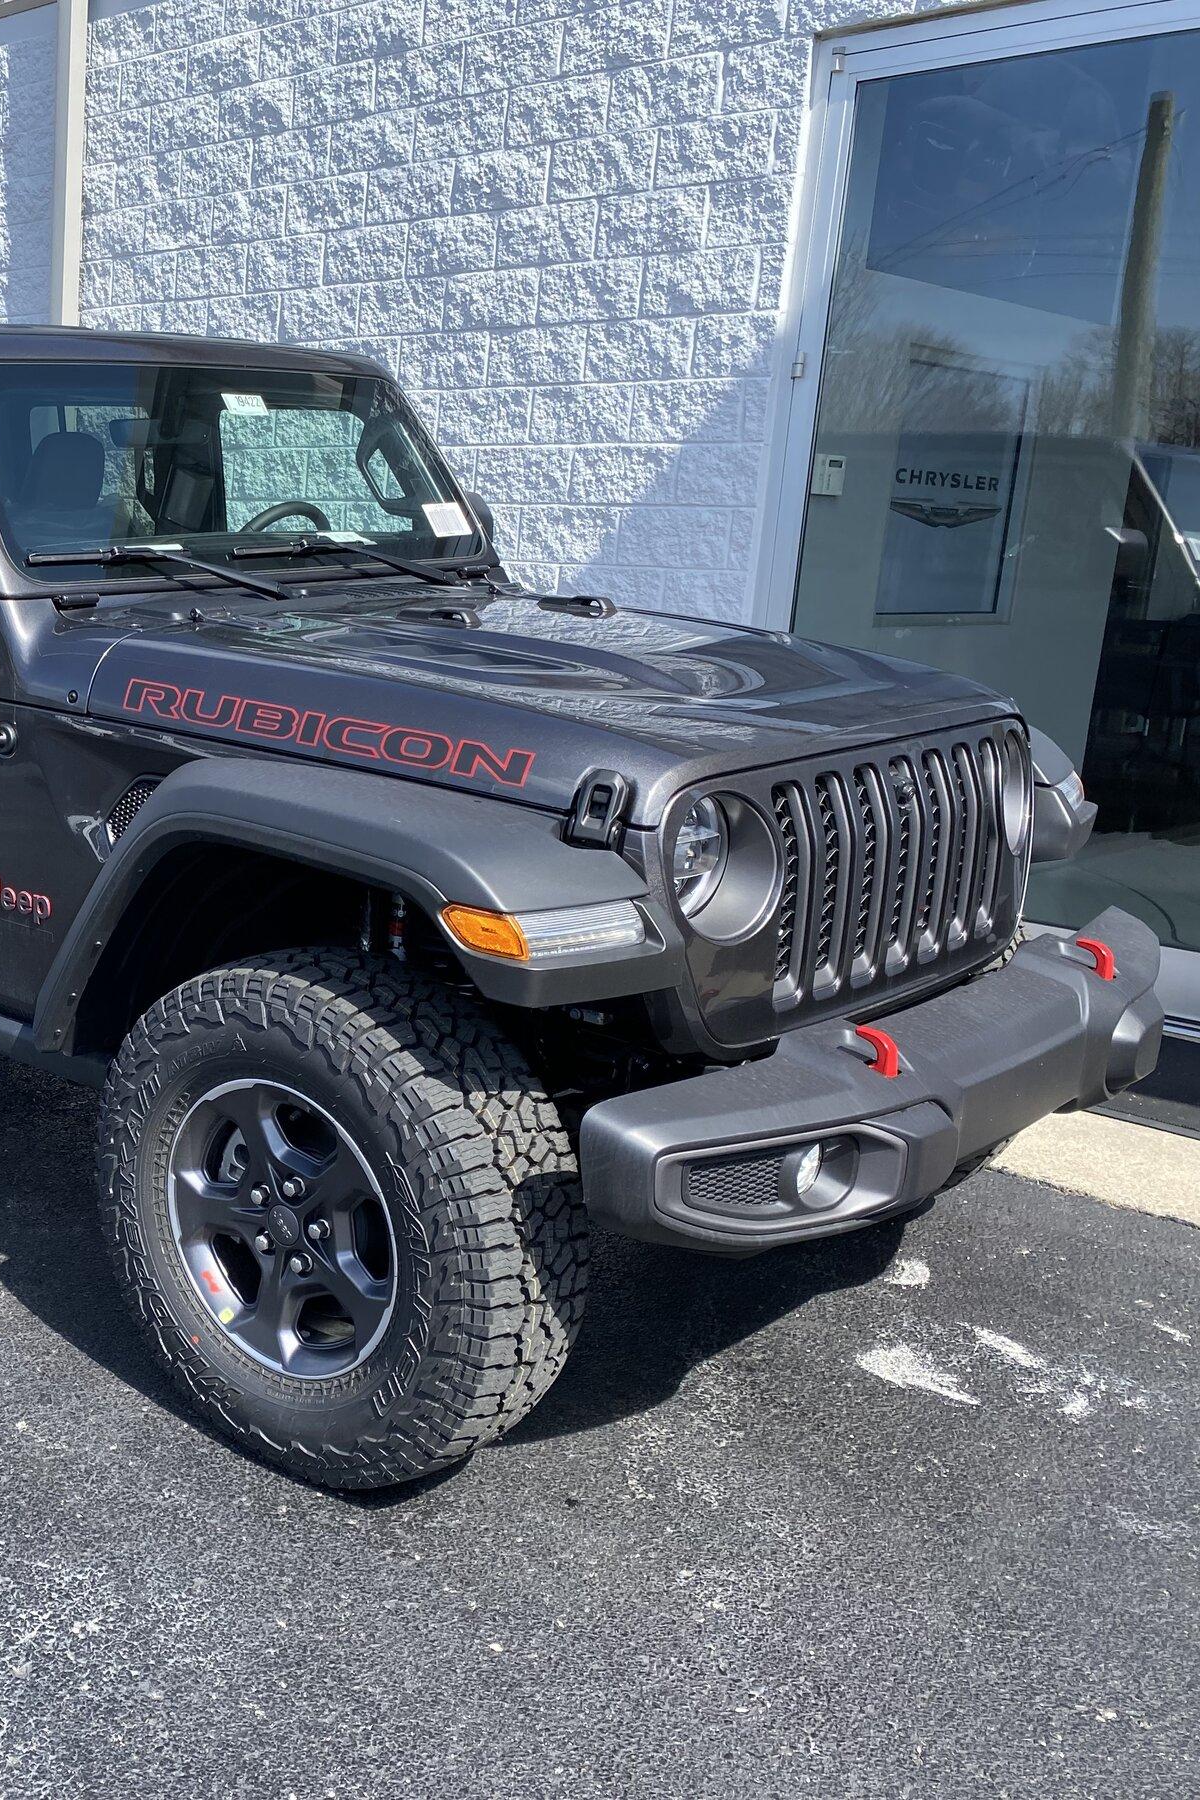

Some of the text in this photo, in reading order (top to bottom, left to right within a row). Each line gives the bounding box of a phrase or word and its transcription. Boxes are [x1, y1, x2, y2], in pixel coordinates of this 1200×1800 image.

[896, 468, 1000, 491] CHRYSLER
[122, 677, 537, 788] RUBICON
[119, 1141, 244, 1409] WILDPEAK
